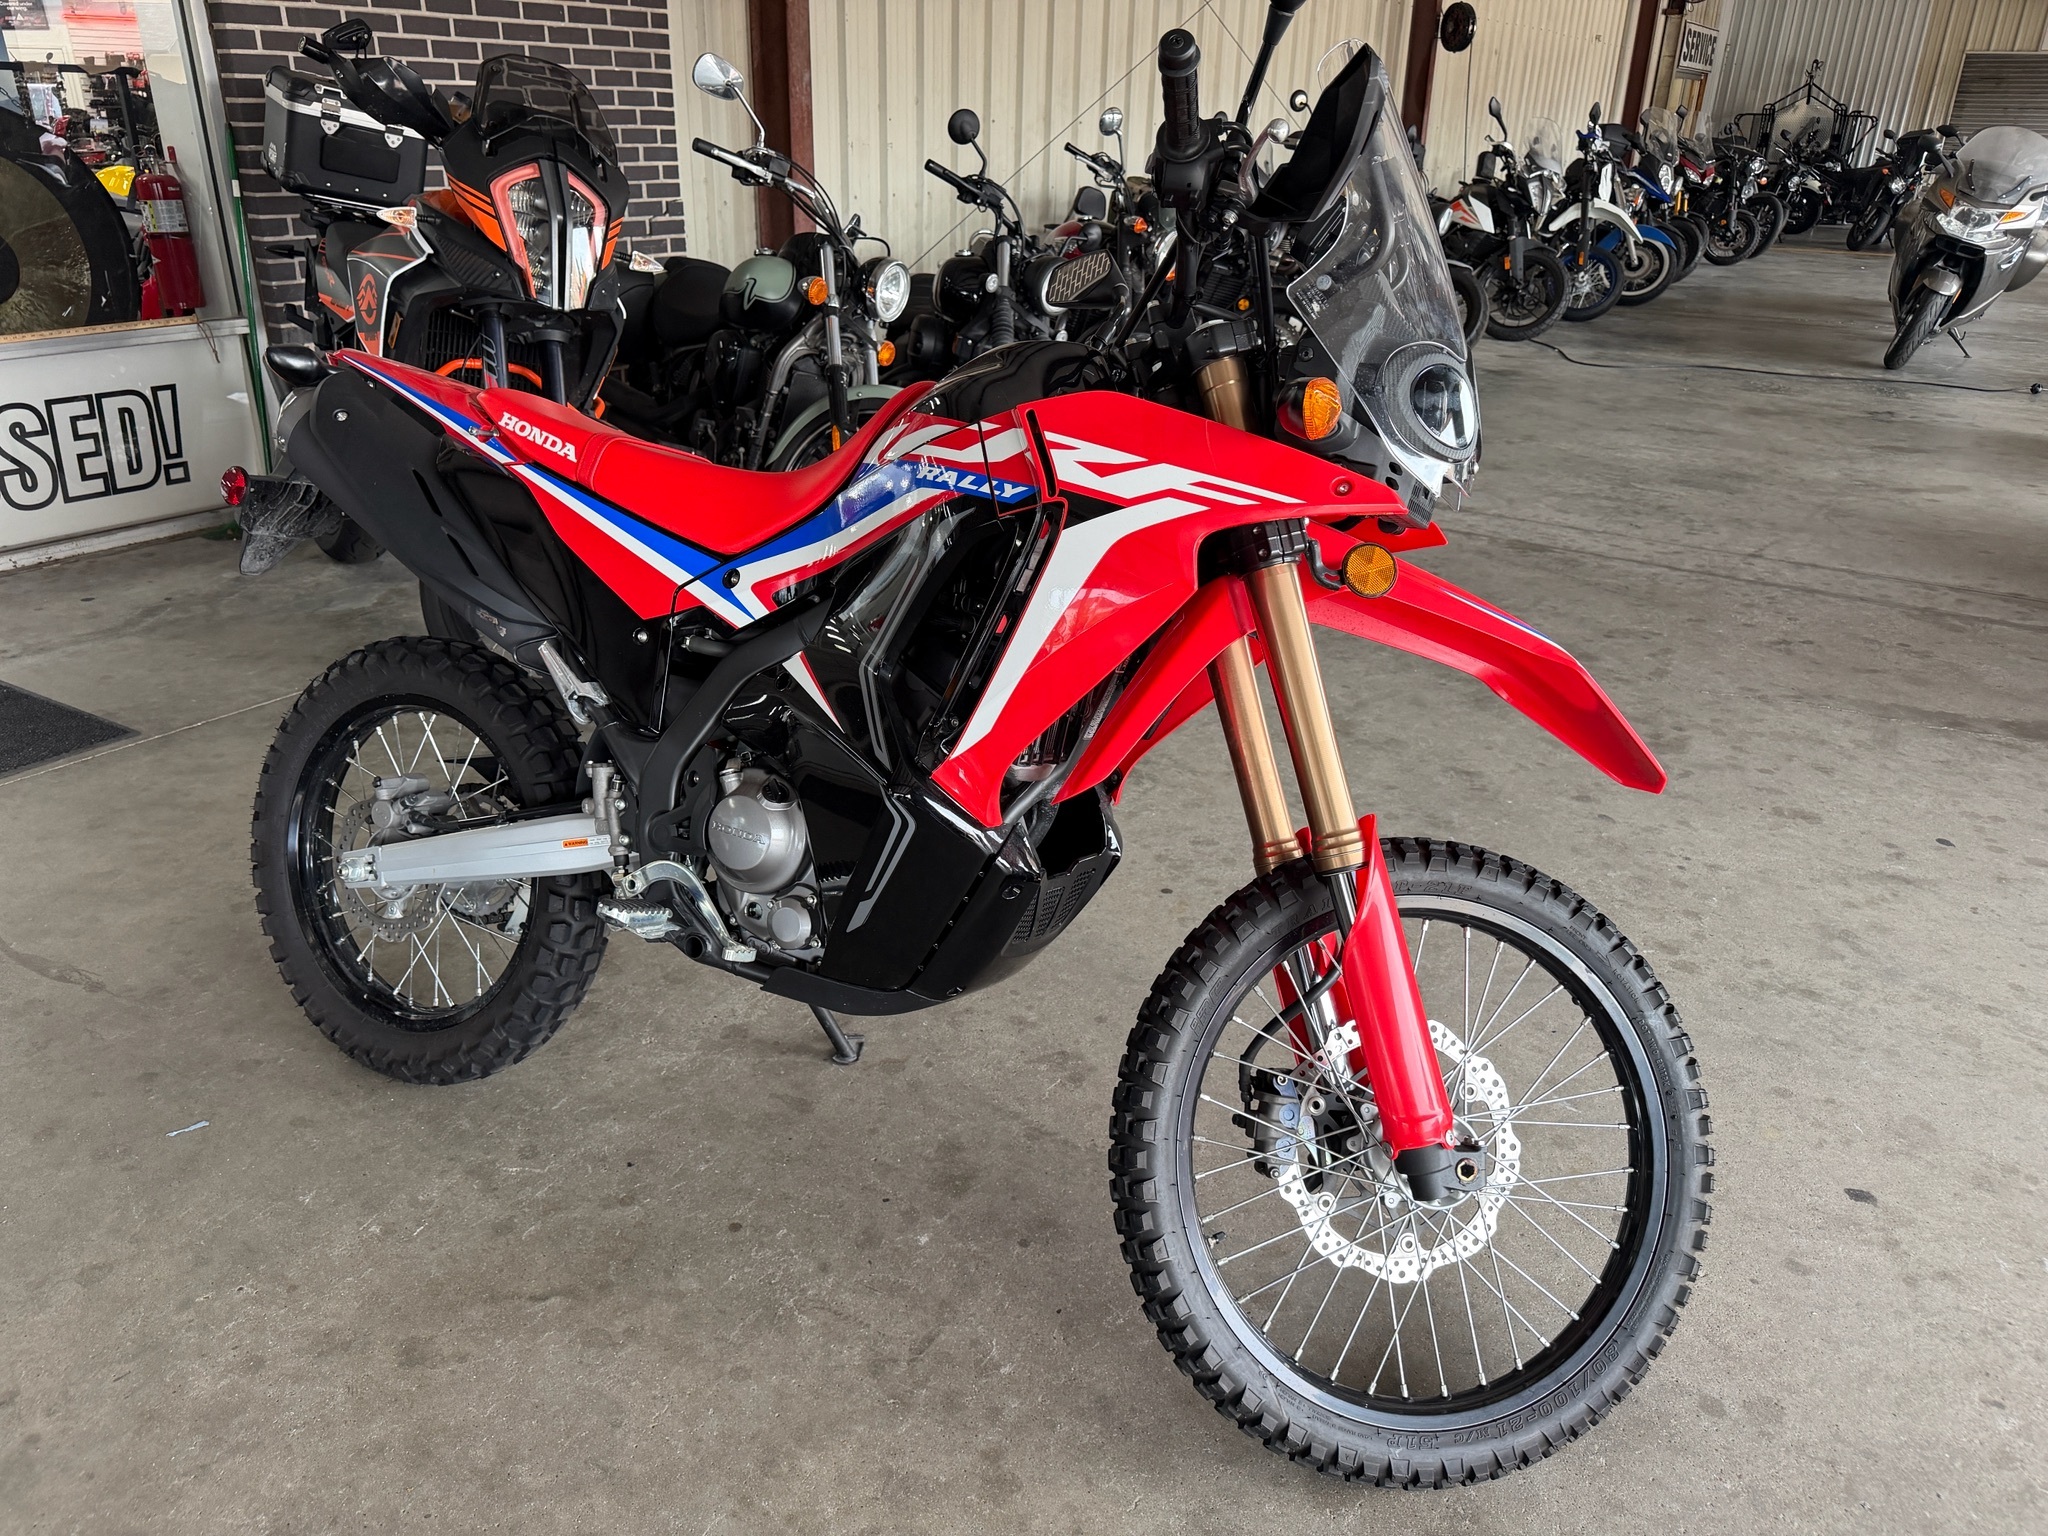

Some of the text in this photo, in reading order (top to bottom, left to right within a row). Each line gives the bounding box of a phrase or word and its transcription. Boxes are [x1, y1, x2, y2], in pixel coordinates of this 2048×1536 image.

[1682, 27, 1718, 67] SERVICE
[498, 411, 578, 463] HONDA
[916, 466, 1029, 498] RALLY
[711, 820, 766, 846] HONDA
